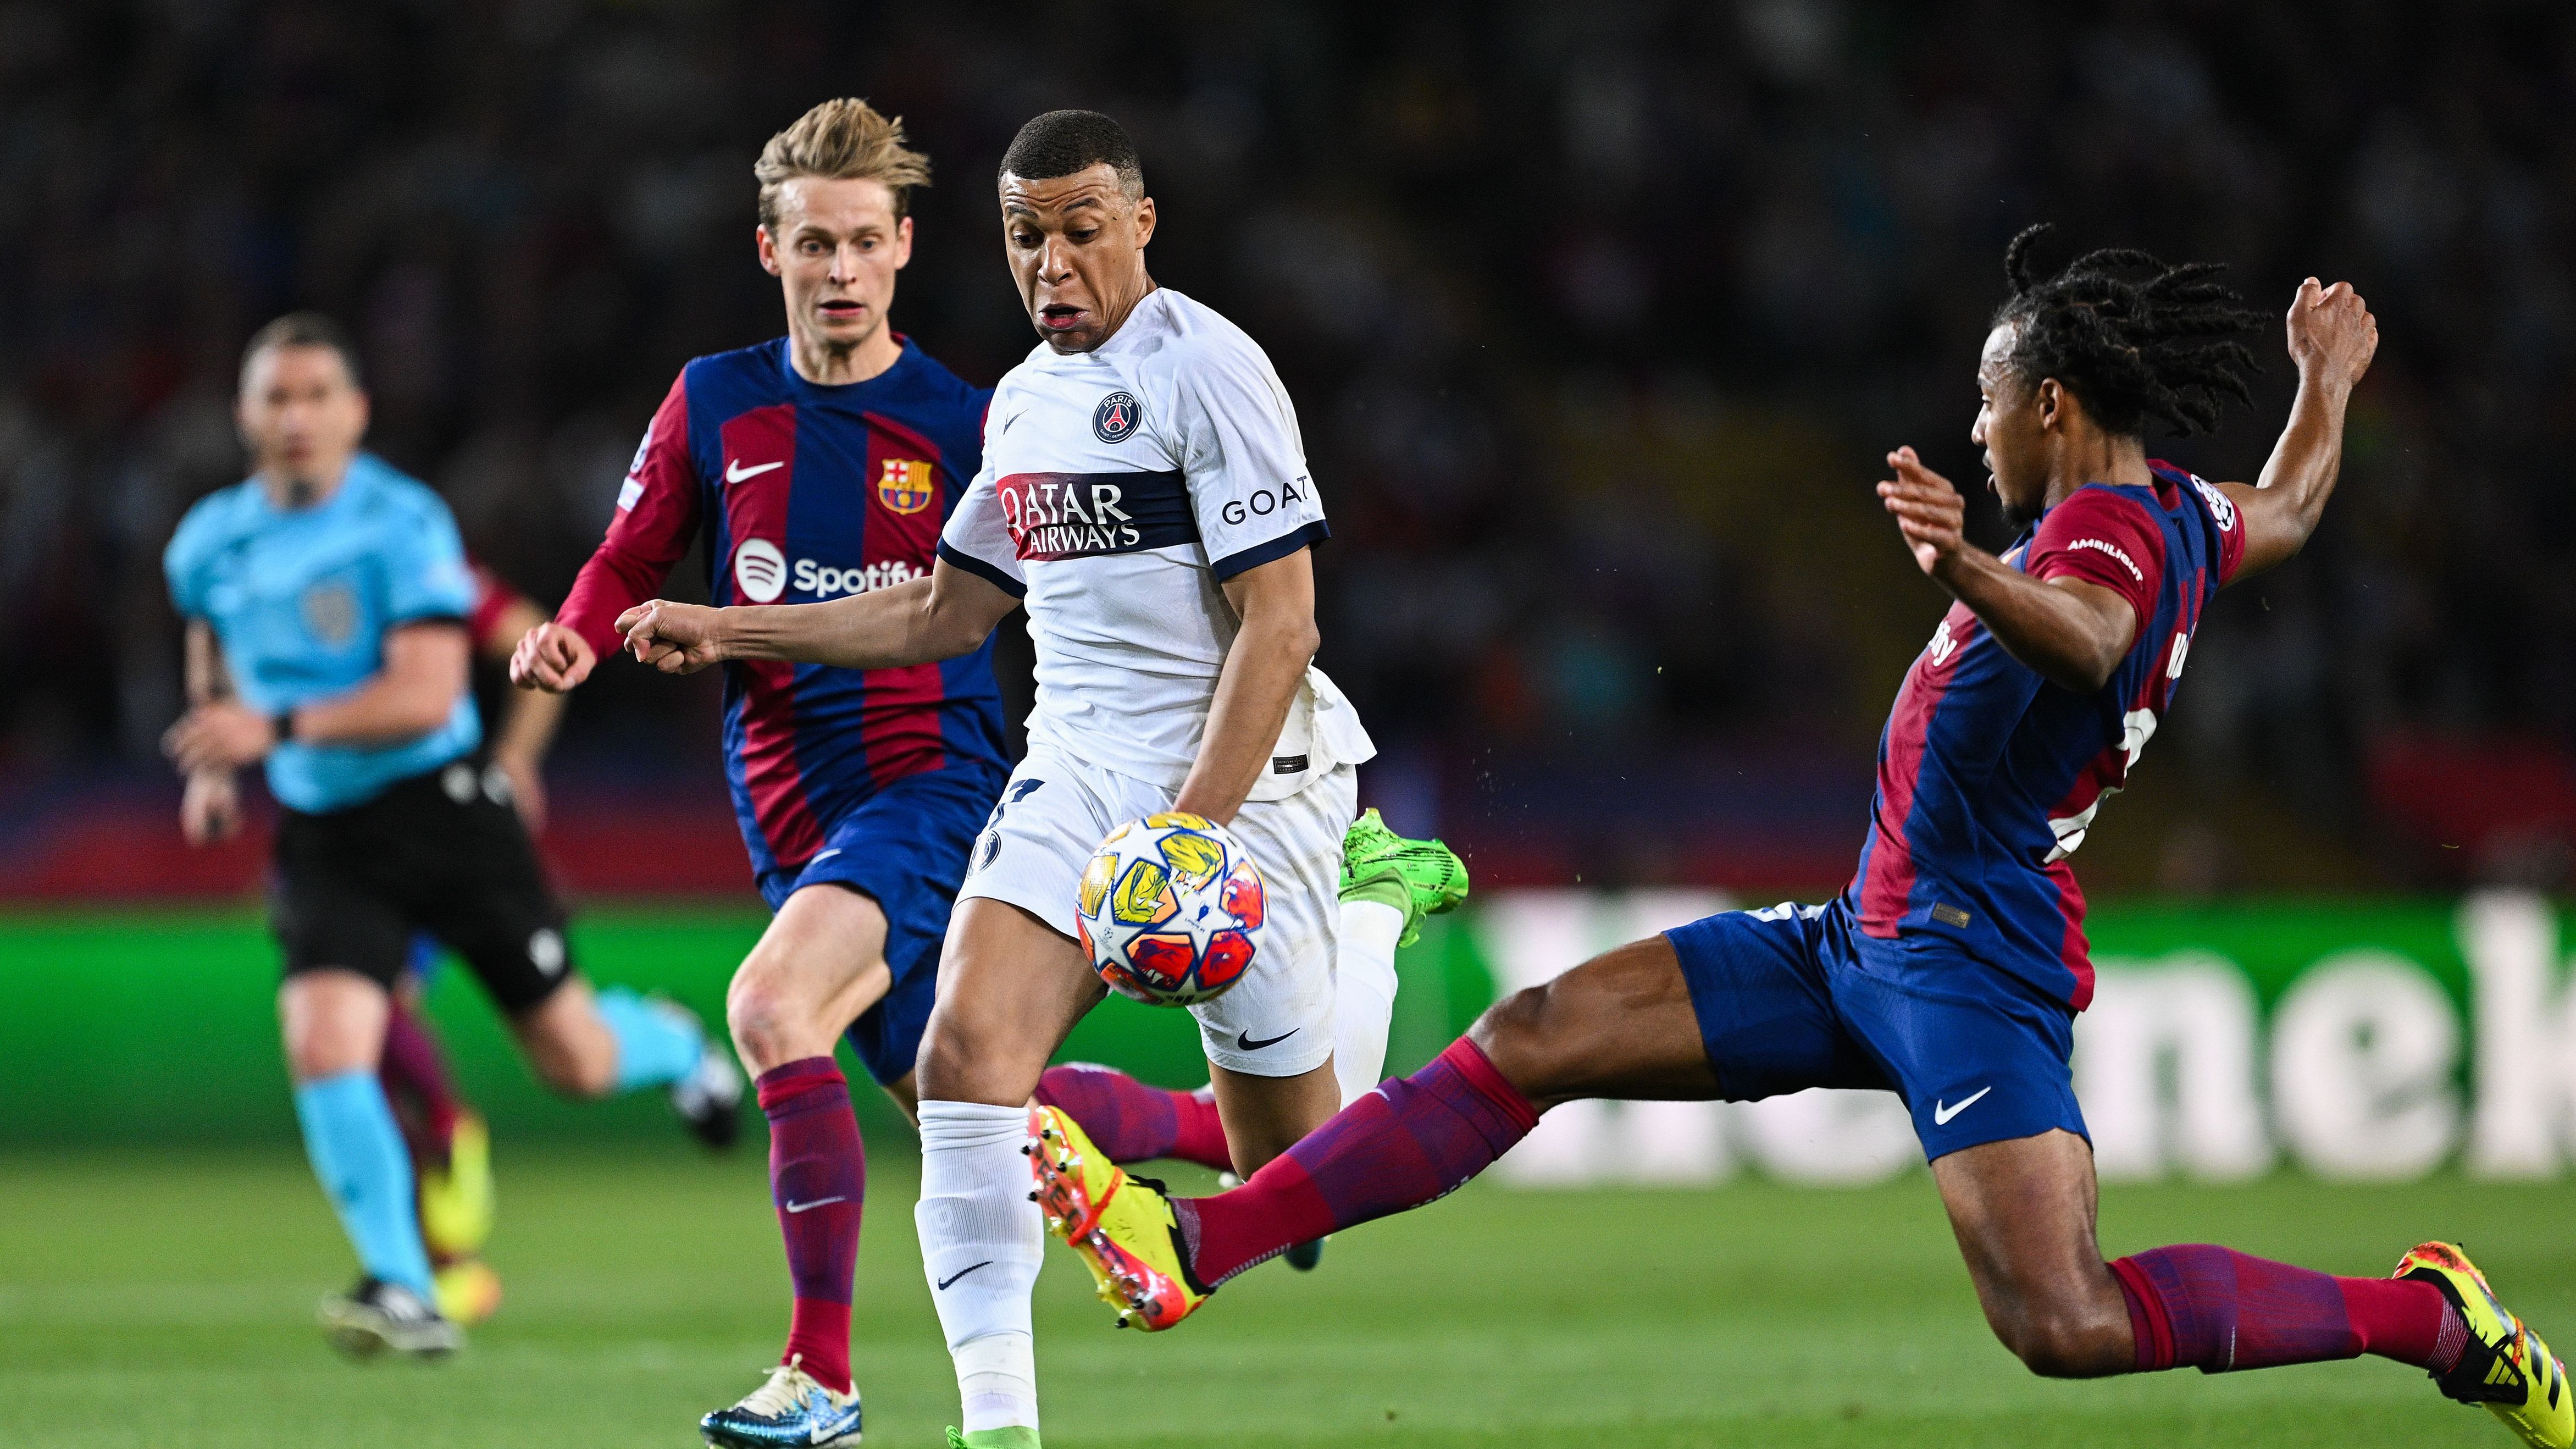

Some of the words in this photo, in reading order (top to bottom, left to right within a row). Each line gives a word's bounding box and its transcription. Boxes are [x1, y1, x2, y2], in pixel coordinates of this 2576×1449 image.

[1104, 395, 1133, 408] PARIS
[1000, 483, 1133, 538] QATAR
[1222, 475, 1308, 526] GOAT
[1029, 523, 1140, 553] AIRWAYS
[2067, 538, 2144, 582] AMBILIGHT
